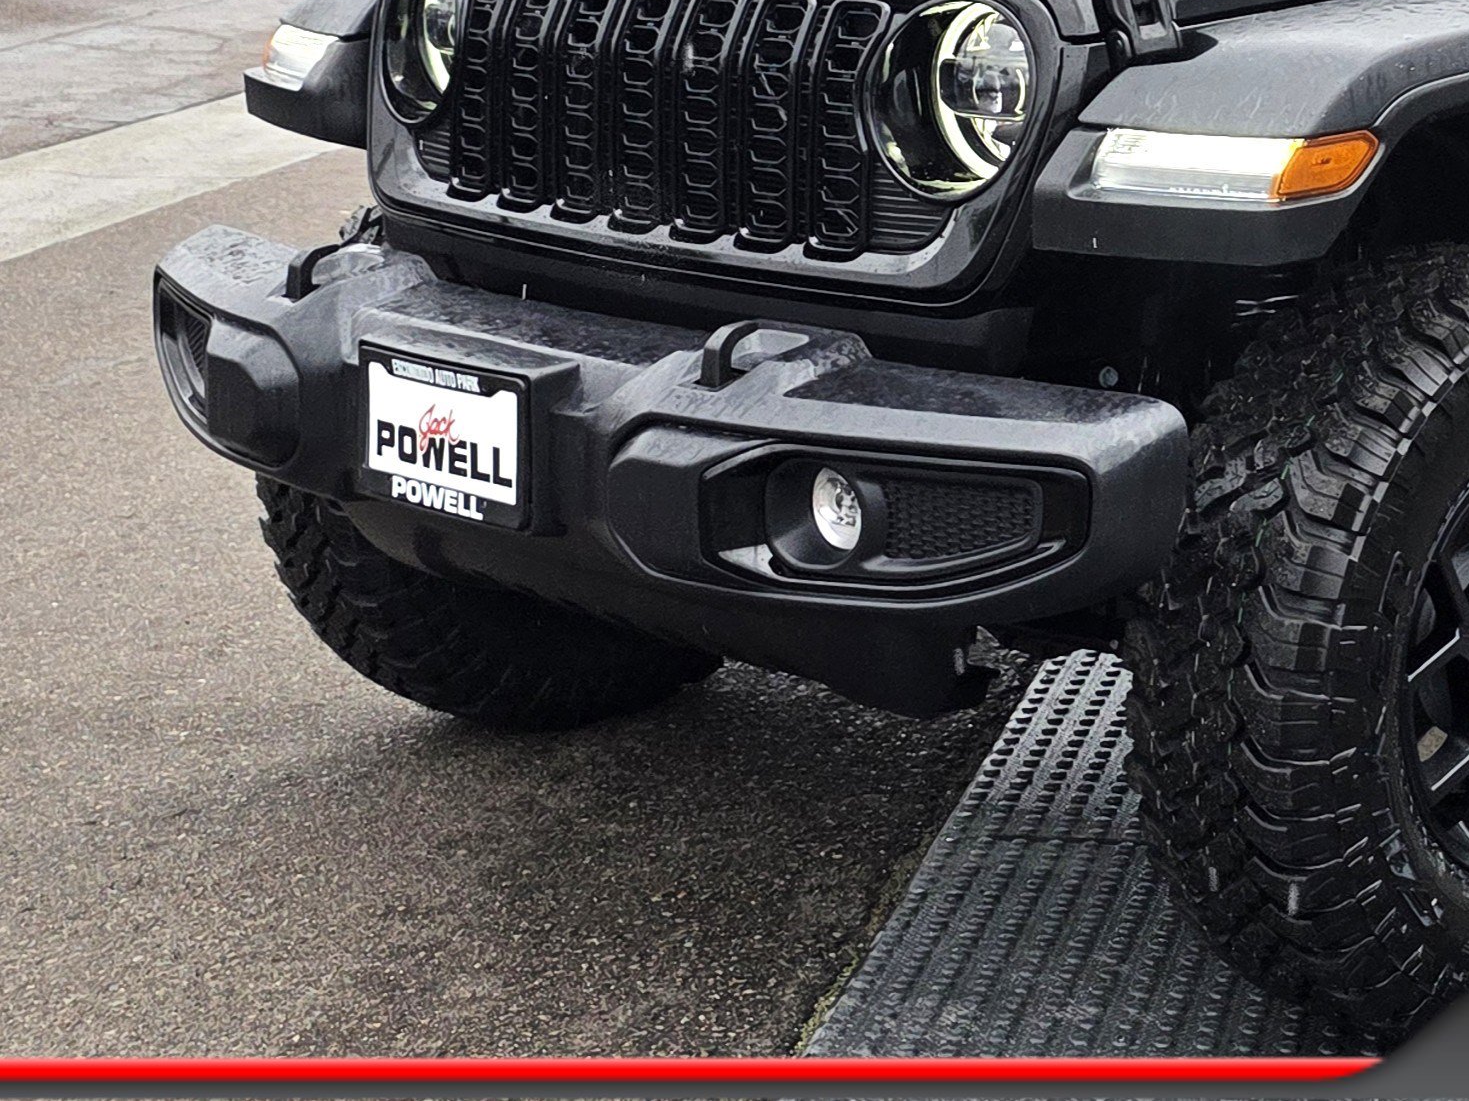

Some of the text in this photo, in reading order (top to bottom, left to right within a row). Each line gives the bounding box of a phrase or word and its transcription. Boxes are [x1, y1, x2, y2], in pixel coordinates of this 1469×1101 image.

[419, 404, 460, 452] Jack
[376, 419, 513, 489] POWELL
[391, 475, 484, 521] POWELL
